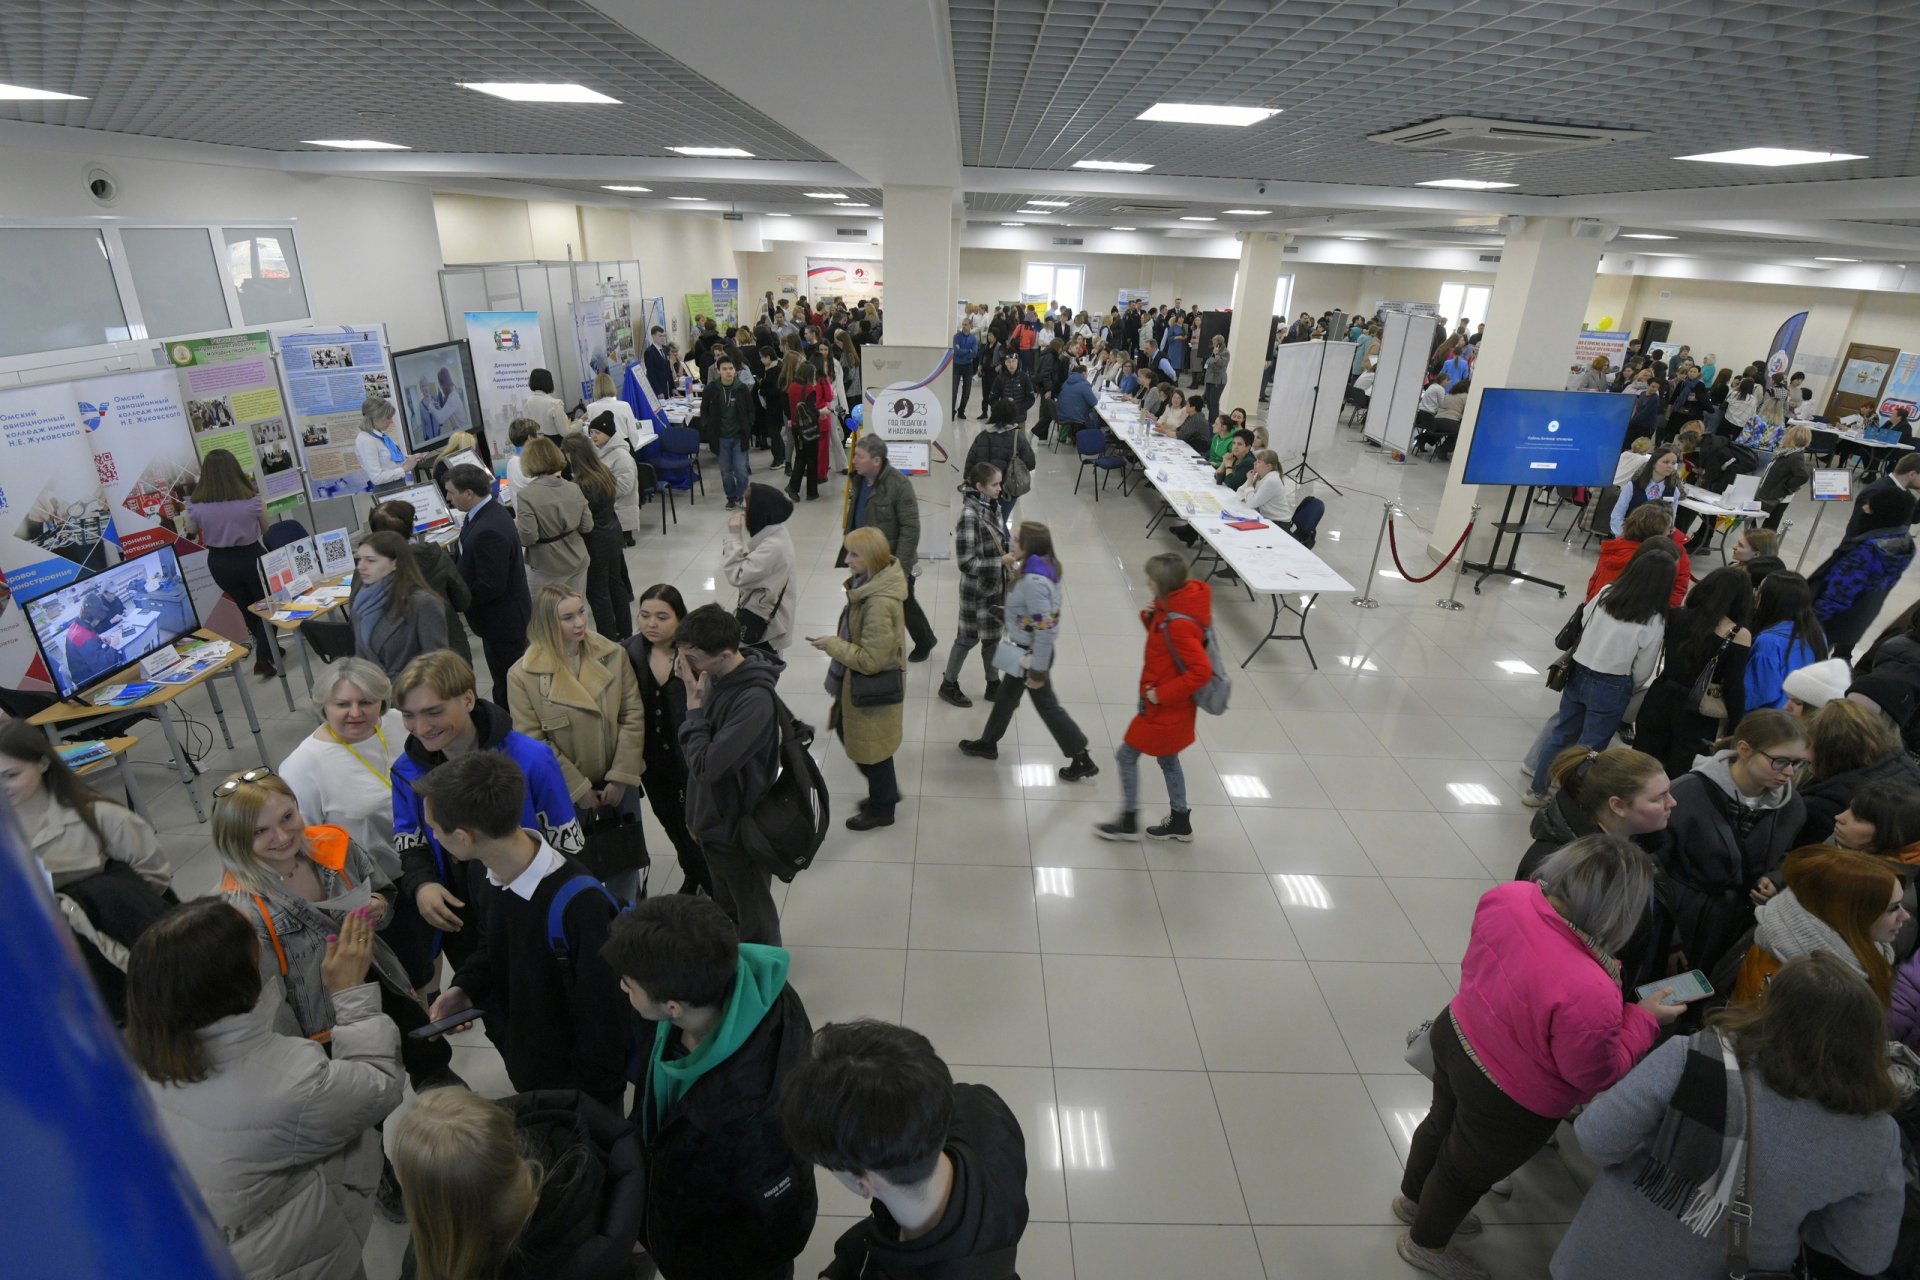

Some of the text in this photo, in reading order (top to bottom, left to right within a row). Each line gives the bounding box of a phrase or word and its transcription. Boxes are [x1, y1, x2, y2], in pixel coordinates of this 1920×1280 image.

[113, 392, 145, 403] Омский
[116, 397, 169, 411] авиационный
[0, 410, 37, 422] Омский
[118, 404, 178, 419] колледж имени
[120, 410, 181, 427] Н.Е. Жуковского
[3, 414, 65, 431] авиационный
[6, 422, 76, 439] колледж имени
[8, 429, 80, 447] Н.Е. Жуковского
[121, 534, 152, 547] роника
